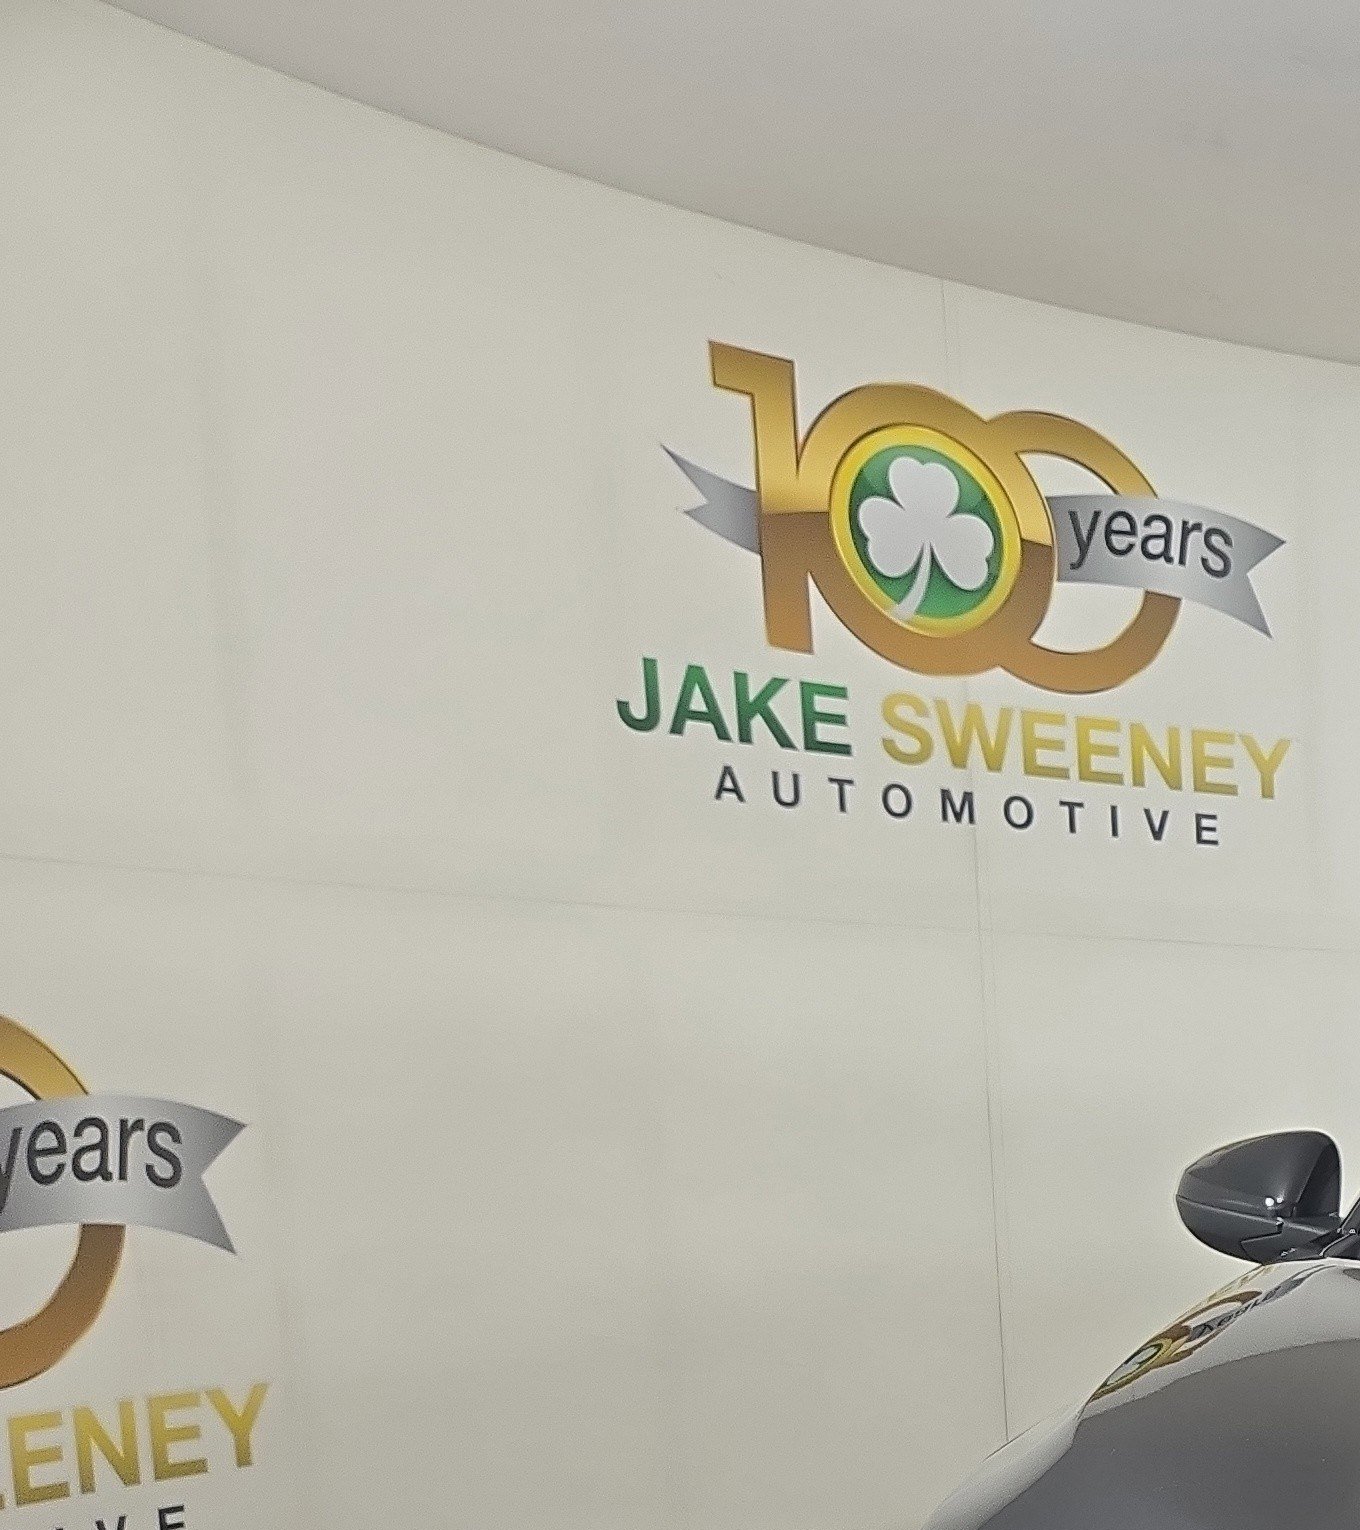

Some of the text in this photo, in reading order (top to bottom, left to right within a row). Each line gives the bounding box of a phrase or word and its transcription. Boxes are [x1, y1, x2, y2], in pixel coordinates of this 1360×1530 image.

[708, 341, 1235, 695] 100 years
[617, 657, 1292, 799] JAKE SWEENEY
[715, 765, 1220, 846] AUTOMOTIVE
[0, 1382, 268, 1510] ENEY
